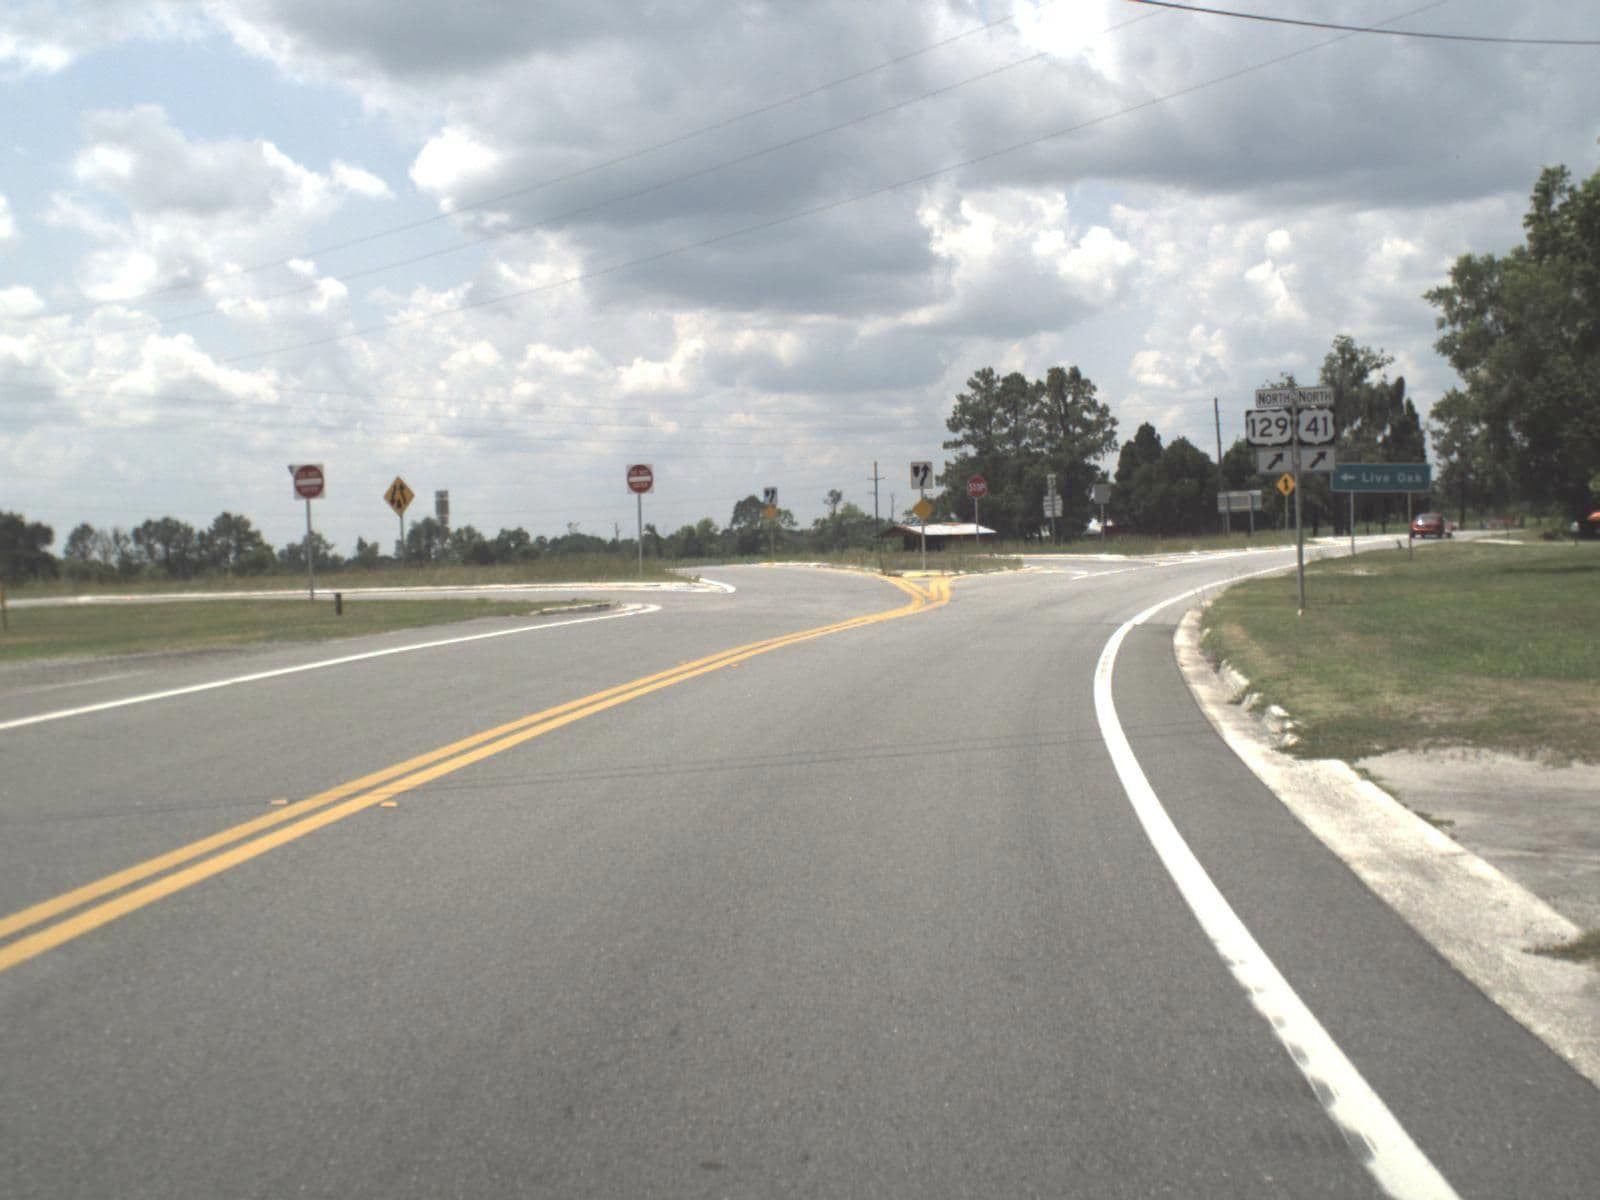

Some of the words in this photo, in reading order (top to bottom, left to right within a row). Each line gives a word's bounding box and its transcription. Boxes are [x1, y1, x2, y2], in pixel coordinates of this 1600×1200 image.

[1258, 393, 1290, 405] NORTH
[1298, 391, 1332, 402] NORTH
[1250, 417, 1288, 437] 129
[1305, 416, 1329, 436] 41
[1361, 471, 1389, 482] Live
[968, 482, 987, 492] STOP
